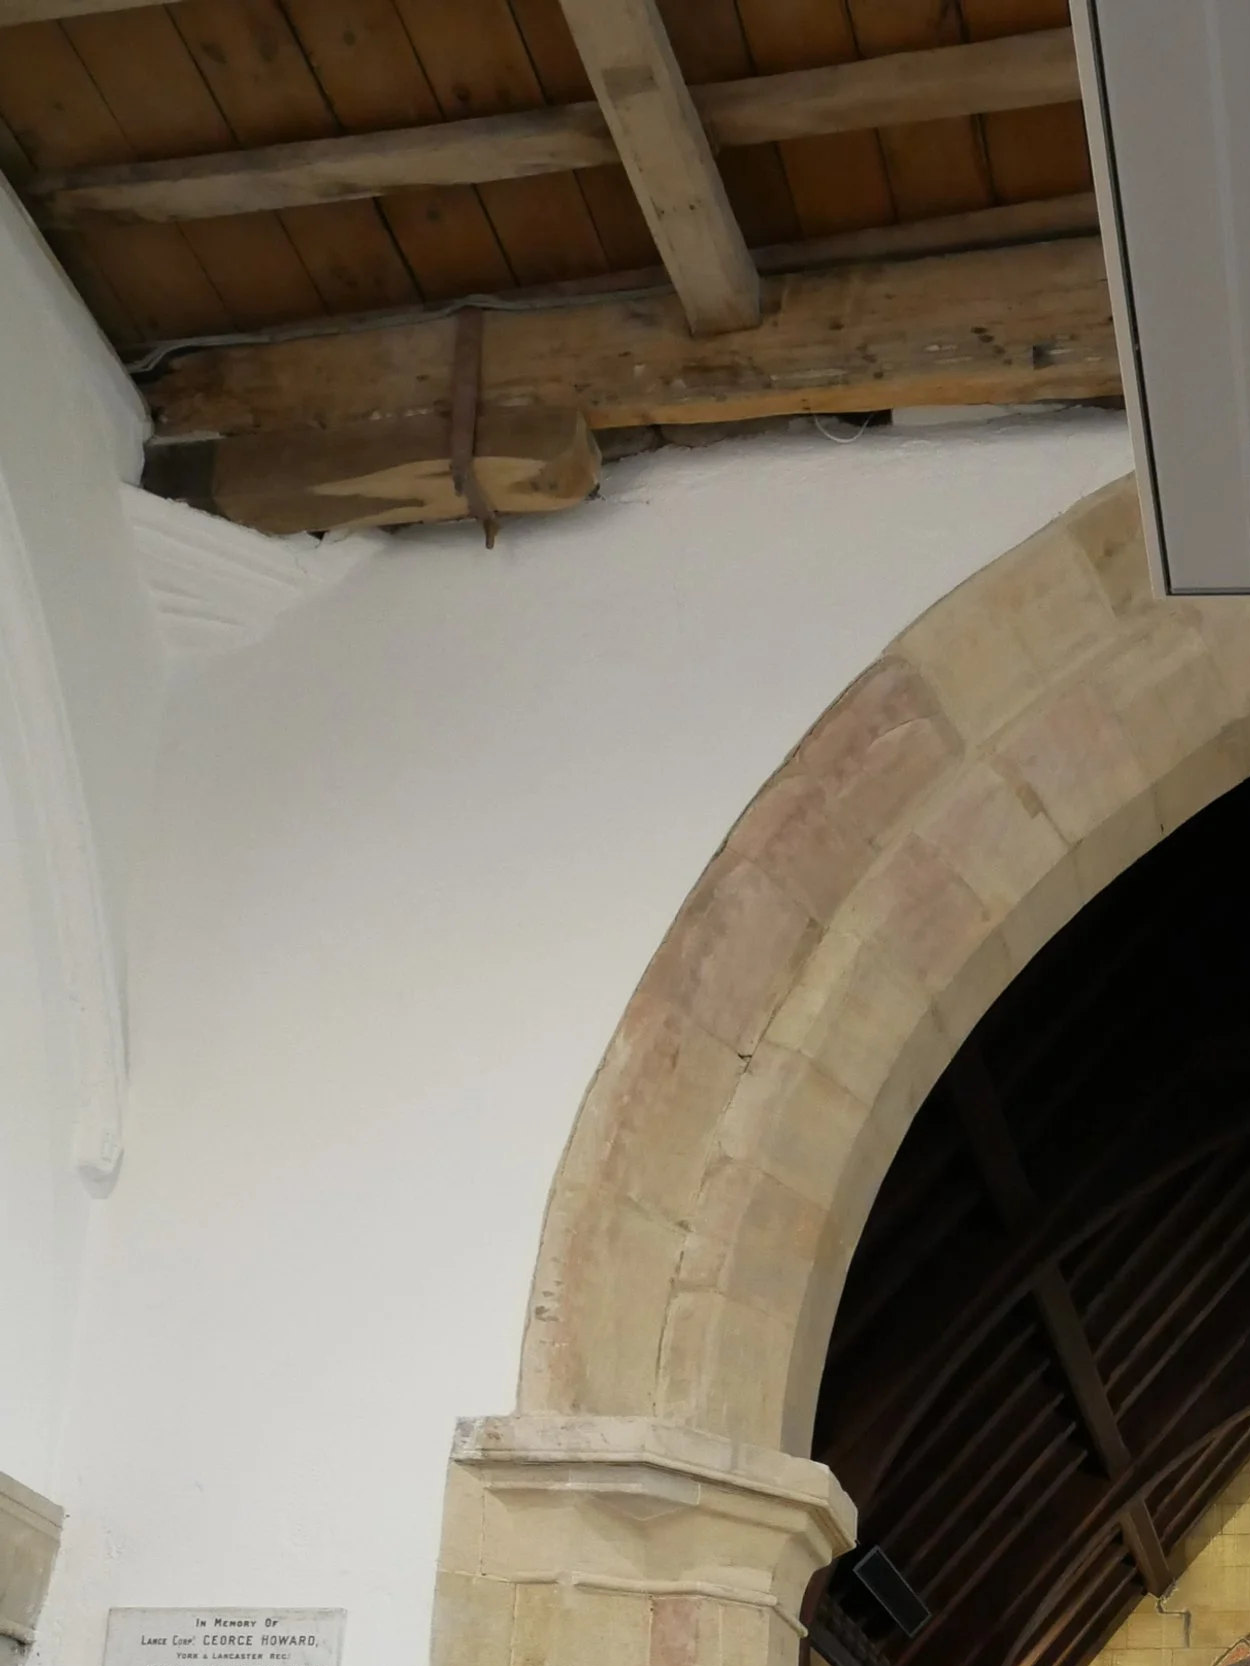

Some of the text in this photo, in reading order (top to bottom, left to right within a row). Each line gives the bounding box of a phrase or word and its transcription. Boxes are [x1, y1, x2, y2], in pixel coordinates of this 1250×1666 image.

[196, 1619, 279, 1627] IN MEMORY OF
[141, 1636, 167, 1646] LANCE
